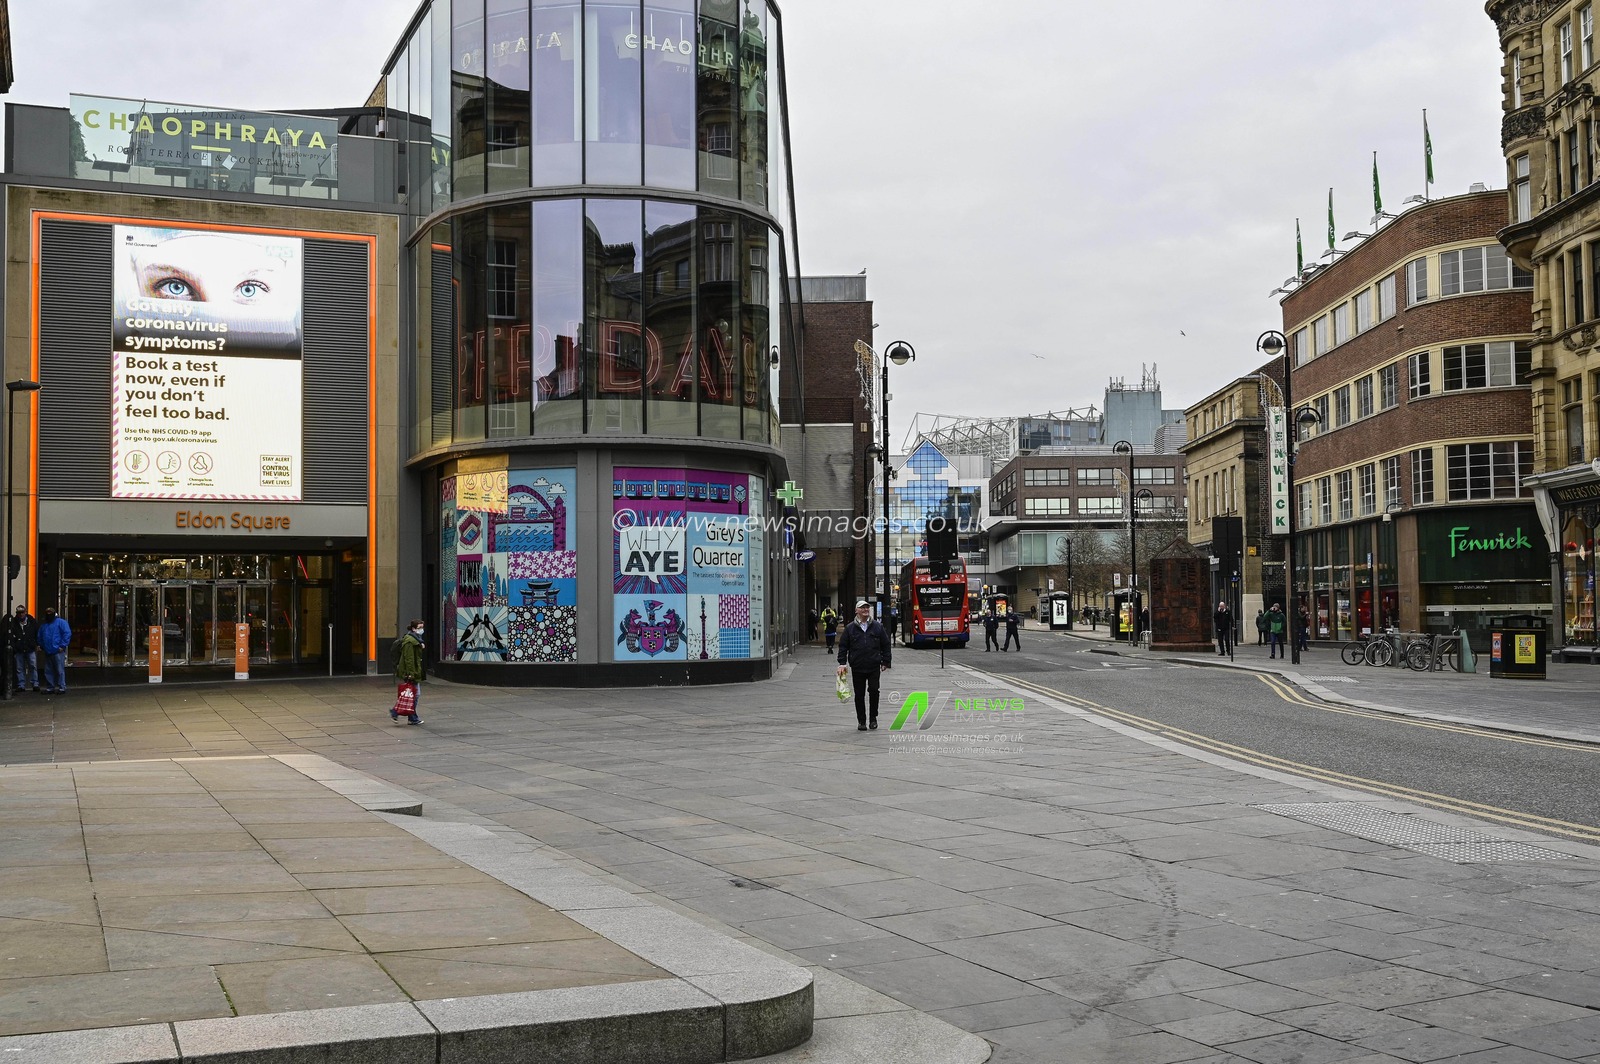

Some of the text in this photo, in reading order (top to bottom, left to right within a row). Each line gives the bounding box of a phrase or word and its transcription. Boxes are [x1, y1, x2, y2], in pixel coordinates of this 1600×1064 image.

[202, 111, 246, 121] DINING
[83, 110, 326, 150] CHAOPHRAYA
[150, 148, 209, 161] TERRACE
[126, 300, 193, 317] Got any
[125, 317, 228, 333] coronavirus
[125, 335, 226, 351] symptoms?
[126, 357, 218, 372] Book a test
[125, 374, 226, 387] now, even if
[125, 388, 205, 402] you don't
[125, 404, 229, 420] feel too bad.
[1273, 415, 1286, 527] FENWICK
[176, 511, 291, 533] Eldon Square
[626, 530, 679, 550] WHY
[1448, 526, 1532, 558] Fenwick
[624, 551, 679, 573] AYE
[693, 546, 744, 568] Quarter.
